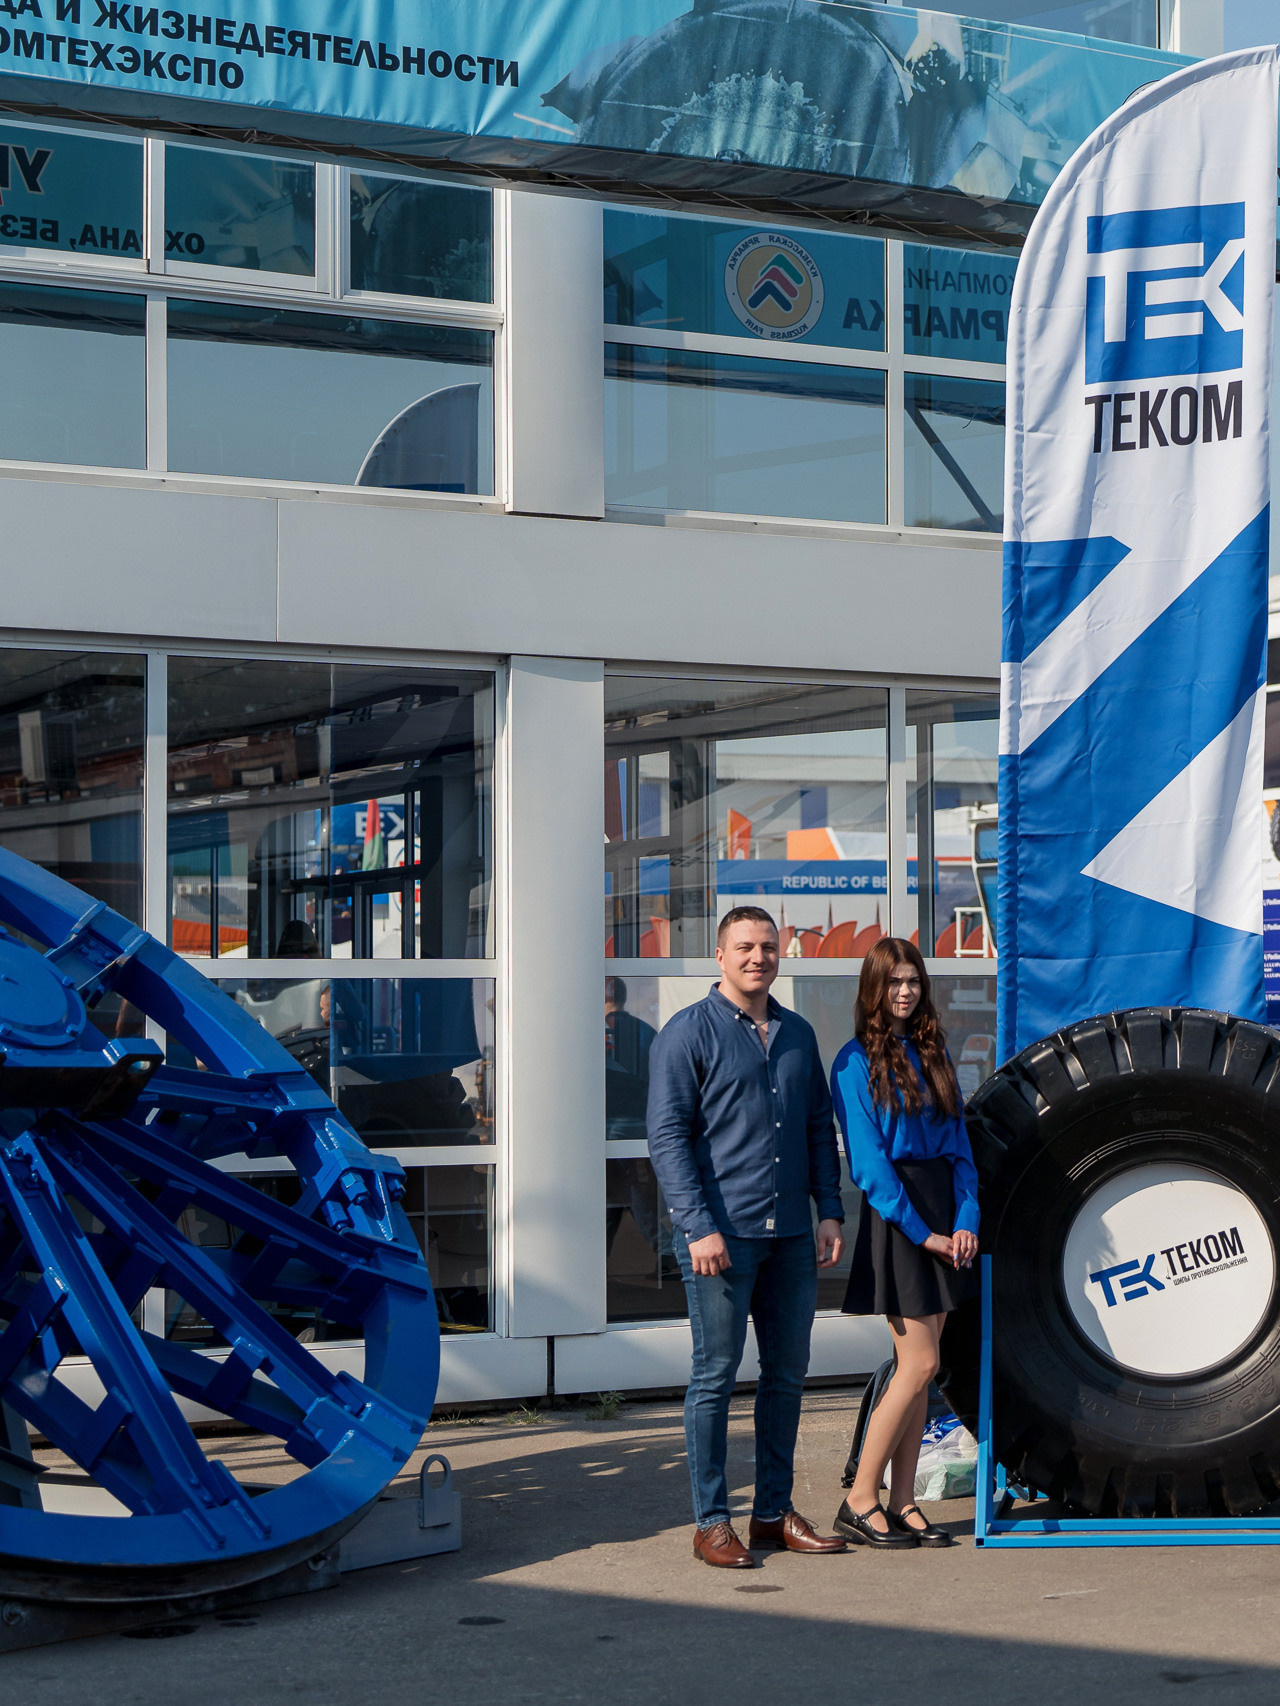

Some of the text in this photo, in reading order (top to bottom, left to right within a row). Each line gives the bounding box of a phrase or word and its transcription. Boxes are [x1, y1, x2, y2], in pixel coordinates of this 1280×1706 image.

[56, 0, 81, 24] И
[92, 0, 519, 87] ЖИЗНЕДЕЯТЕЛЬНОСТИ
[1085, 380, 1243, 453] ТЕКОМ
[782, 876, 847, 888] REPUBLIC
[851, 876, 868, 888] OF
[1161, 1227, 1244, 1276] ТЕКОМ
